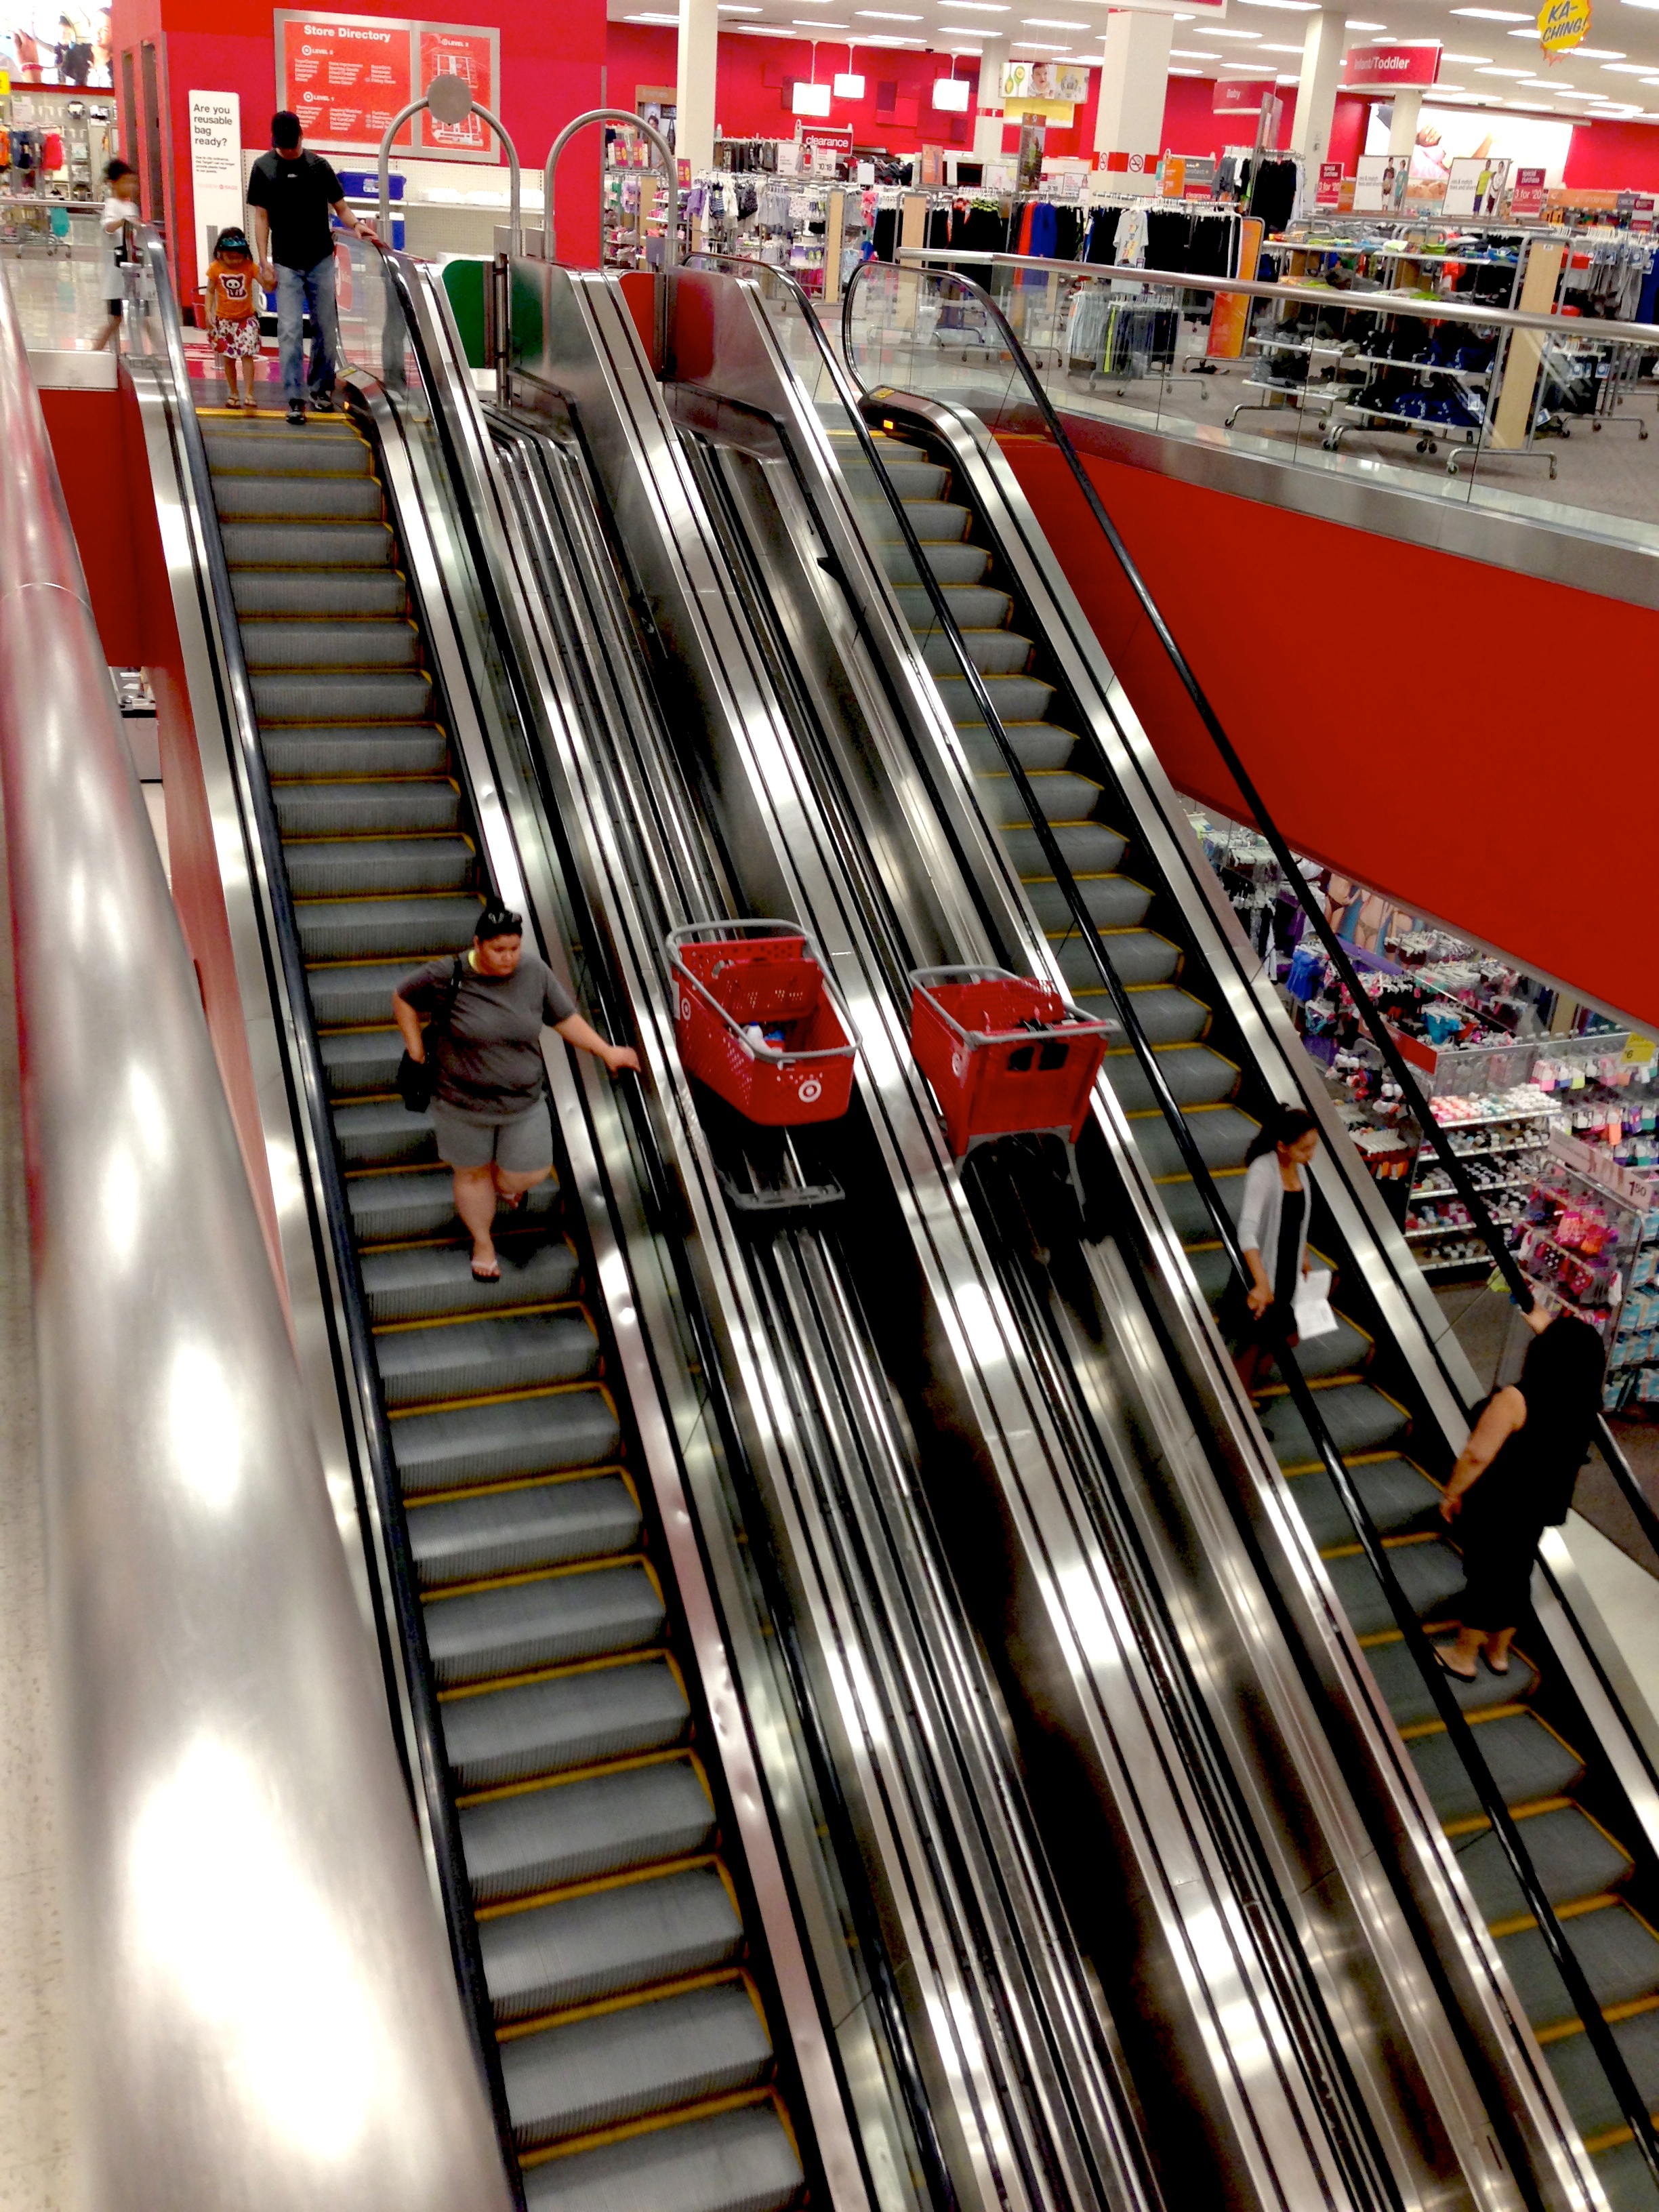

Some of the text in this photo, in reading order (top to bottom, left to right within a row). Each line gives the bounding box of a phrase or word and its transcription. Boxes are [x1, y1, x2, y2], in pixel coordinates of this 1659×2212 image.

[1548, 1, 1578, 24] KA-
[304, 24, 391, 43] Store Directory
[1542, 17, 1586, 41] CHING!
[194, 104, 230, 115] Are you
[194, 116, 233, 125] reusable
[194, 125, 211, 136] bag
[194, 138, 228, 148] ready?
[806, 135, 848, 148] clearance
[1515, 189, 1519, 198] 3
[1521, 189, 1530, 199] for
